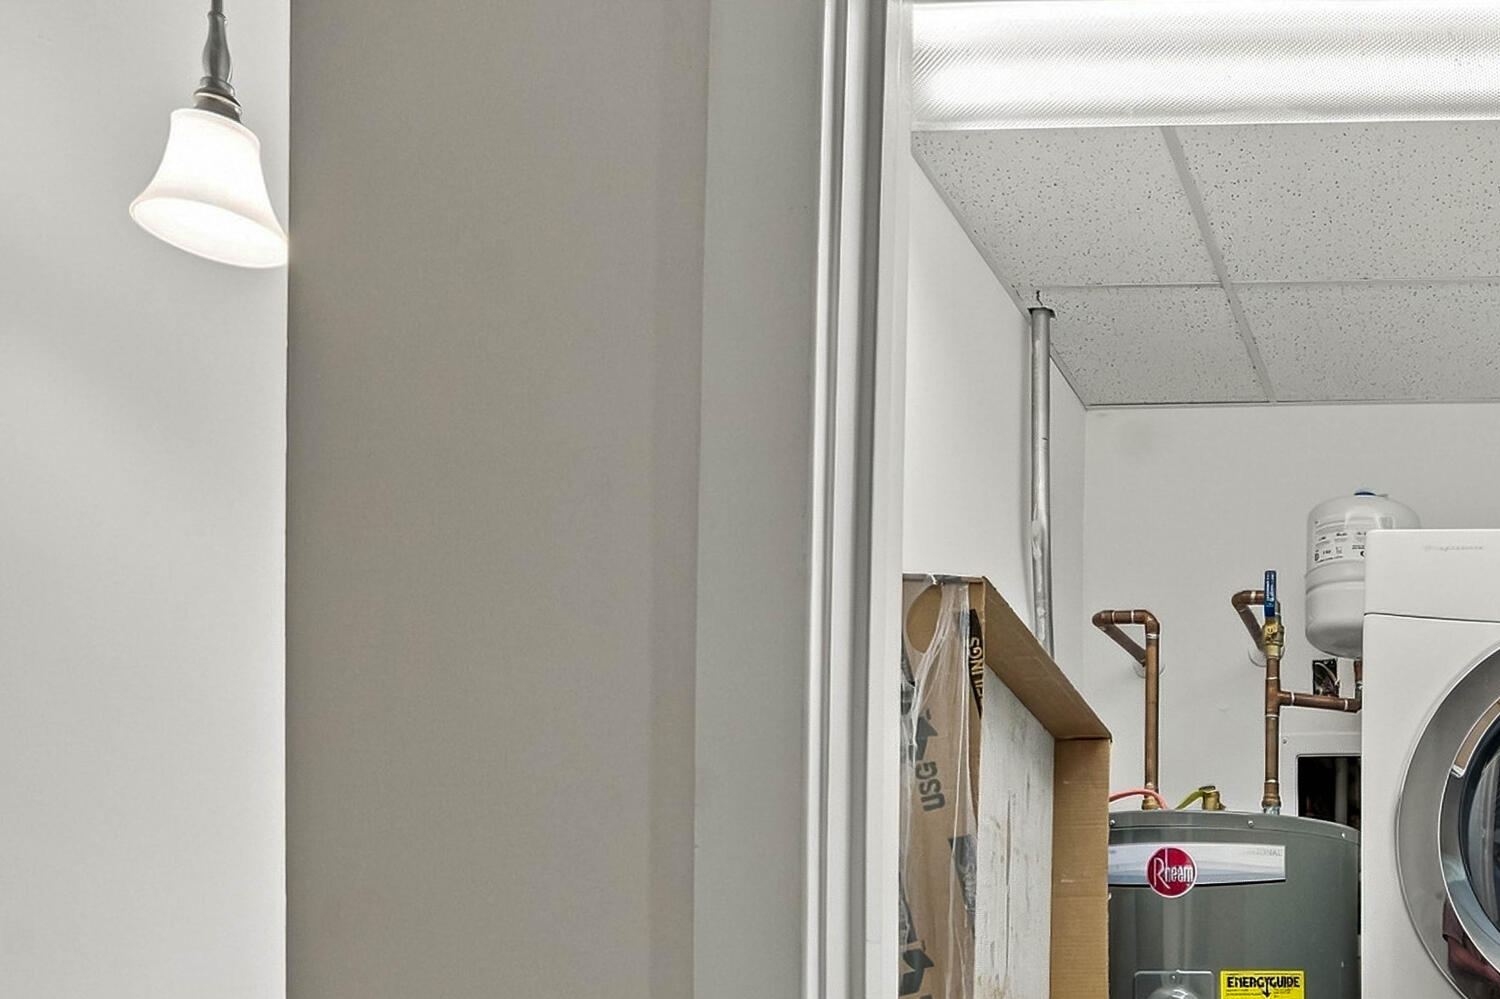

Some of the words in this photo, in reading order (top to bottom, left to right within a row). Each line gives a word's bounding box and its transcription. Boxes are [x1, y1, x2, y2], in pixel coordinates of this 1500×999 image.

[968, 636, 985, 700] EILINGS
[914, 760, 946, 813] USG
[1153, 848, 1194, 890] Rheem
